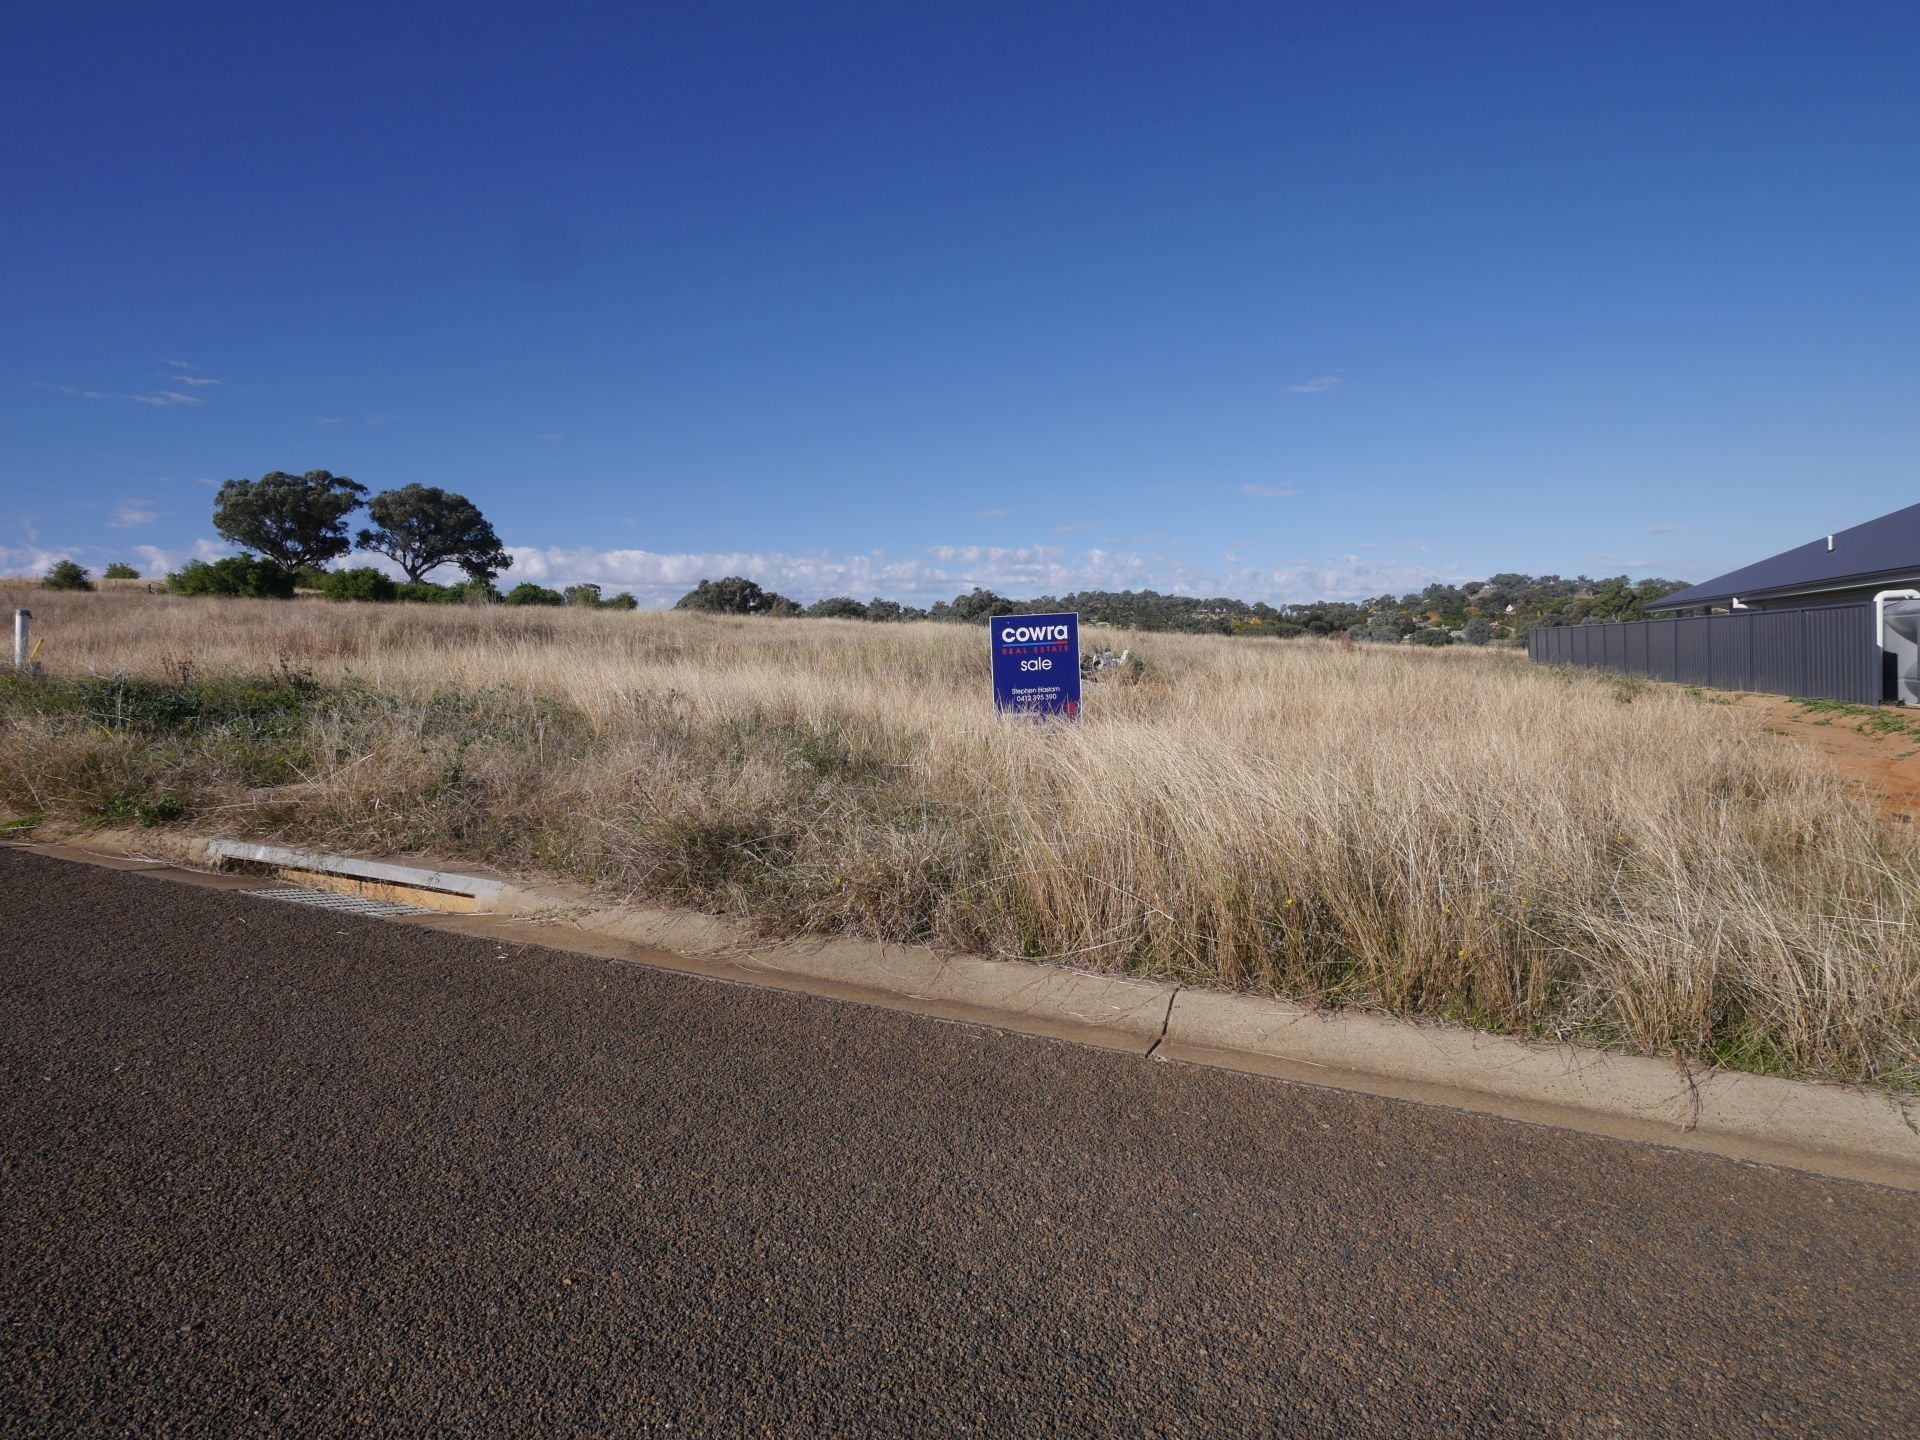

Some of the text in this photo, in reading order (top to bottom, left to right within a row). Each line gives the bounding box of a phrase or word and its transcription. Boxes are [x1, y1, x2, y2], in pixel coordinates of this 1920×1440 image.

[1002, 625, 1068, 643] cowra
[1002, 644, 1069, 655] REAL ESTATE
[1020, 656, 1052, 671] sale
[1011, 687, 1037, 695] Stephen
